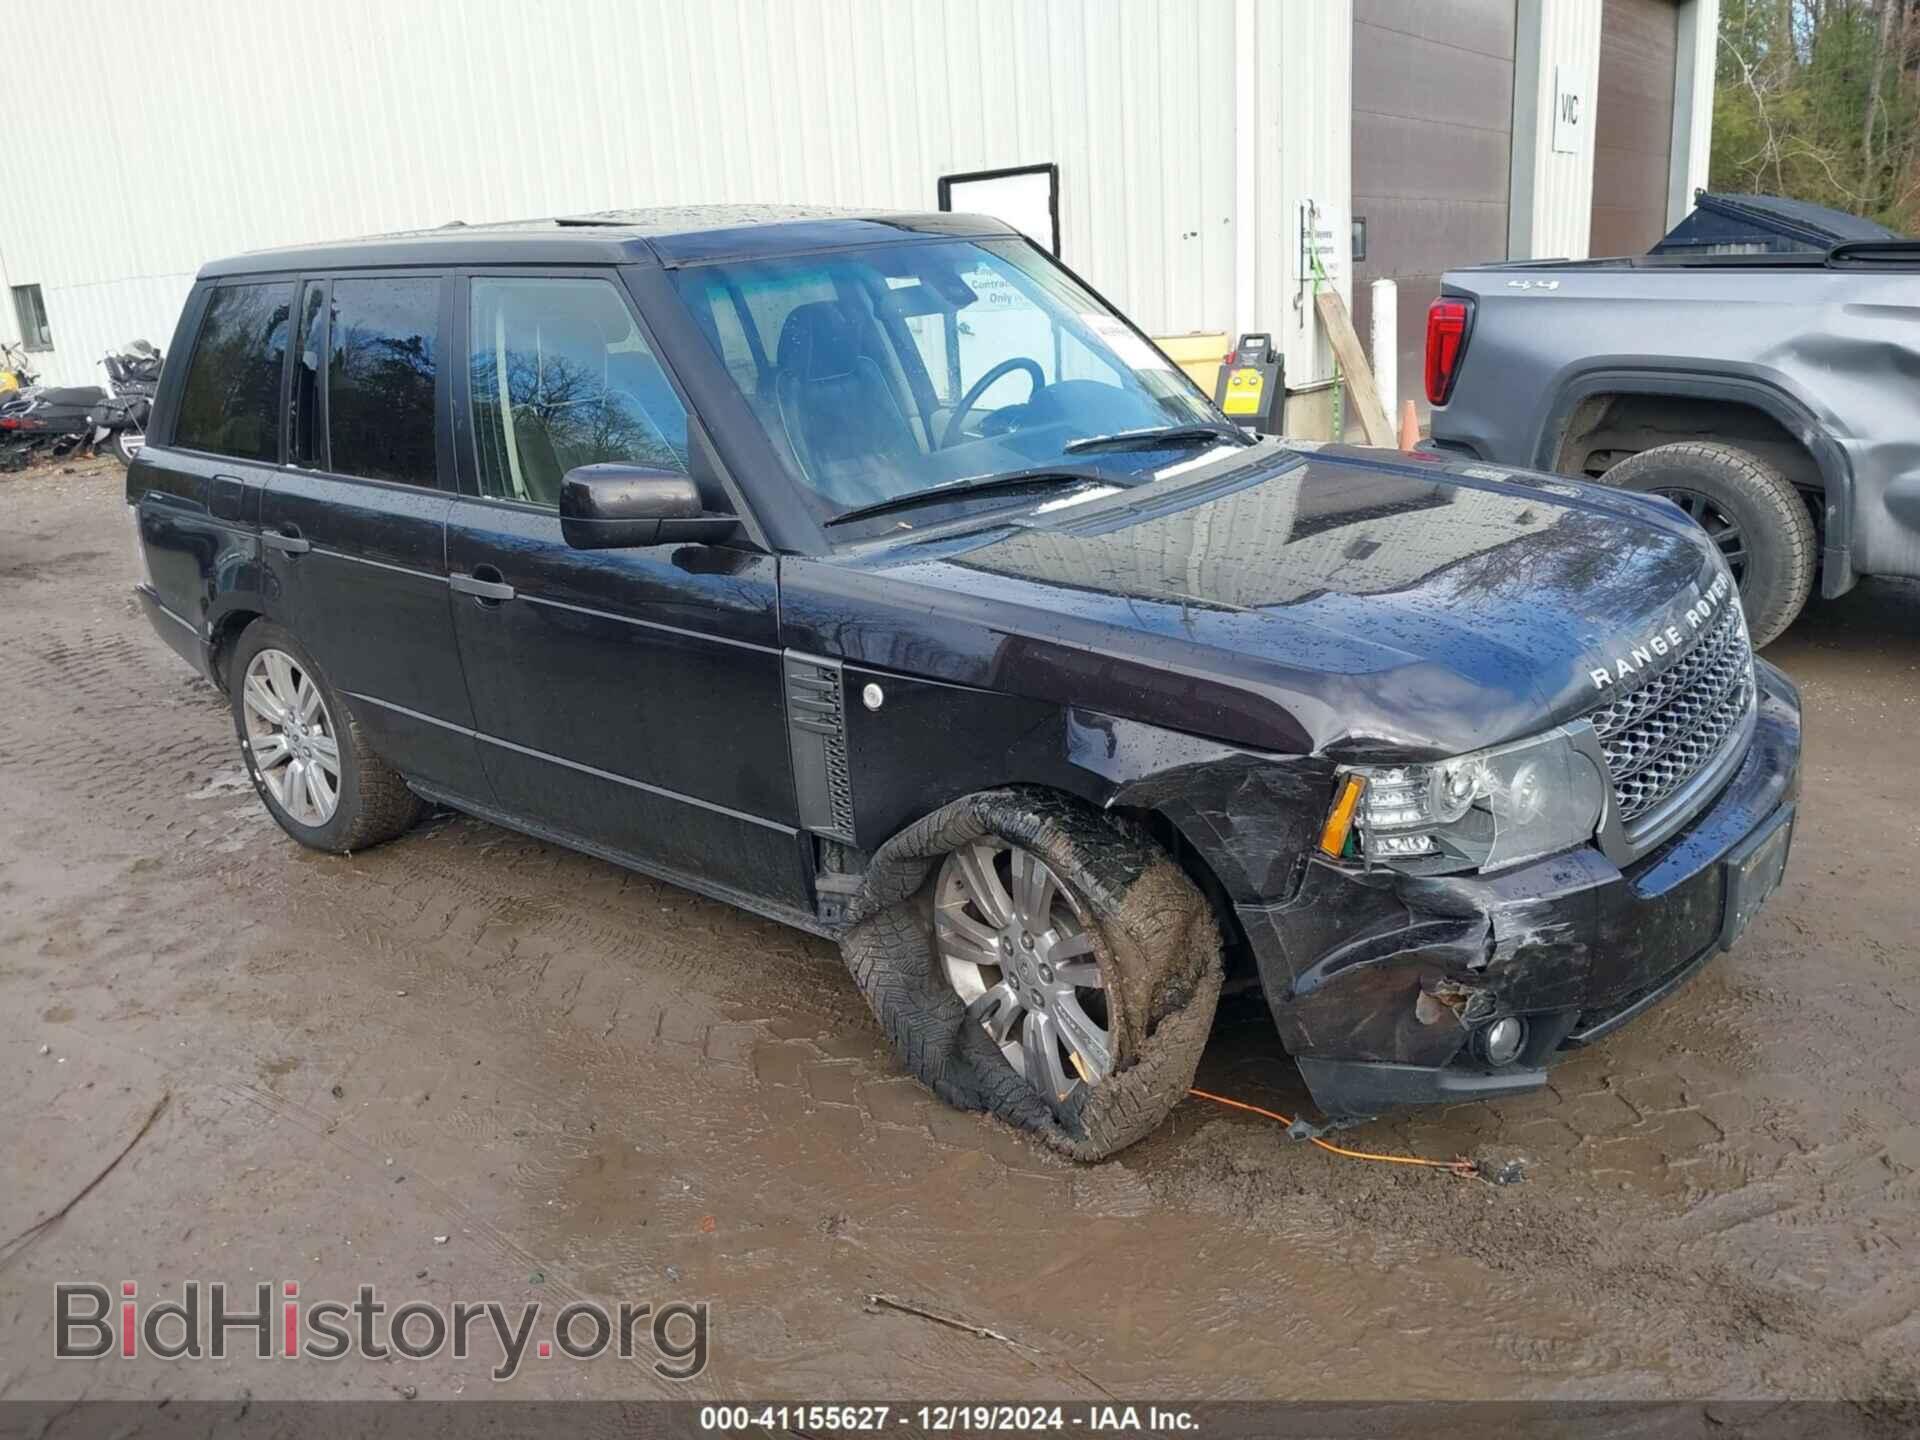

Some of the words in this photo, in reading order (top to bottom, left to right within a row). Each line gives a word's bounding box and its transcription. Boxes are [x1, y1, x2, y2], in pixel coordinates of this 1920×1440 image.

[1561, 93, 1578, 125] VIC
[1507, 279, 1560, 290] 44
[1589, 626, 1683, 689] RANGE
